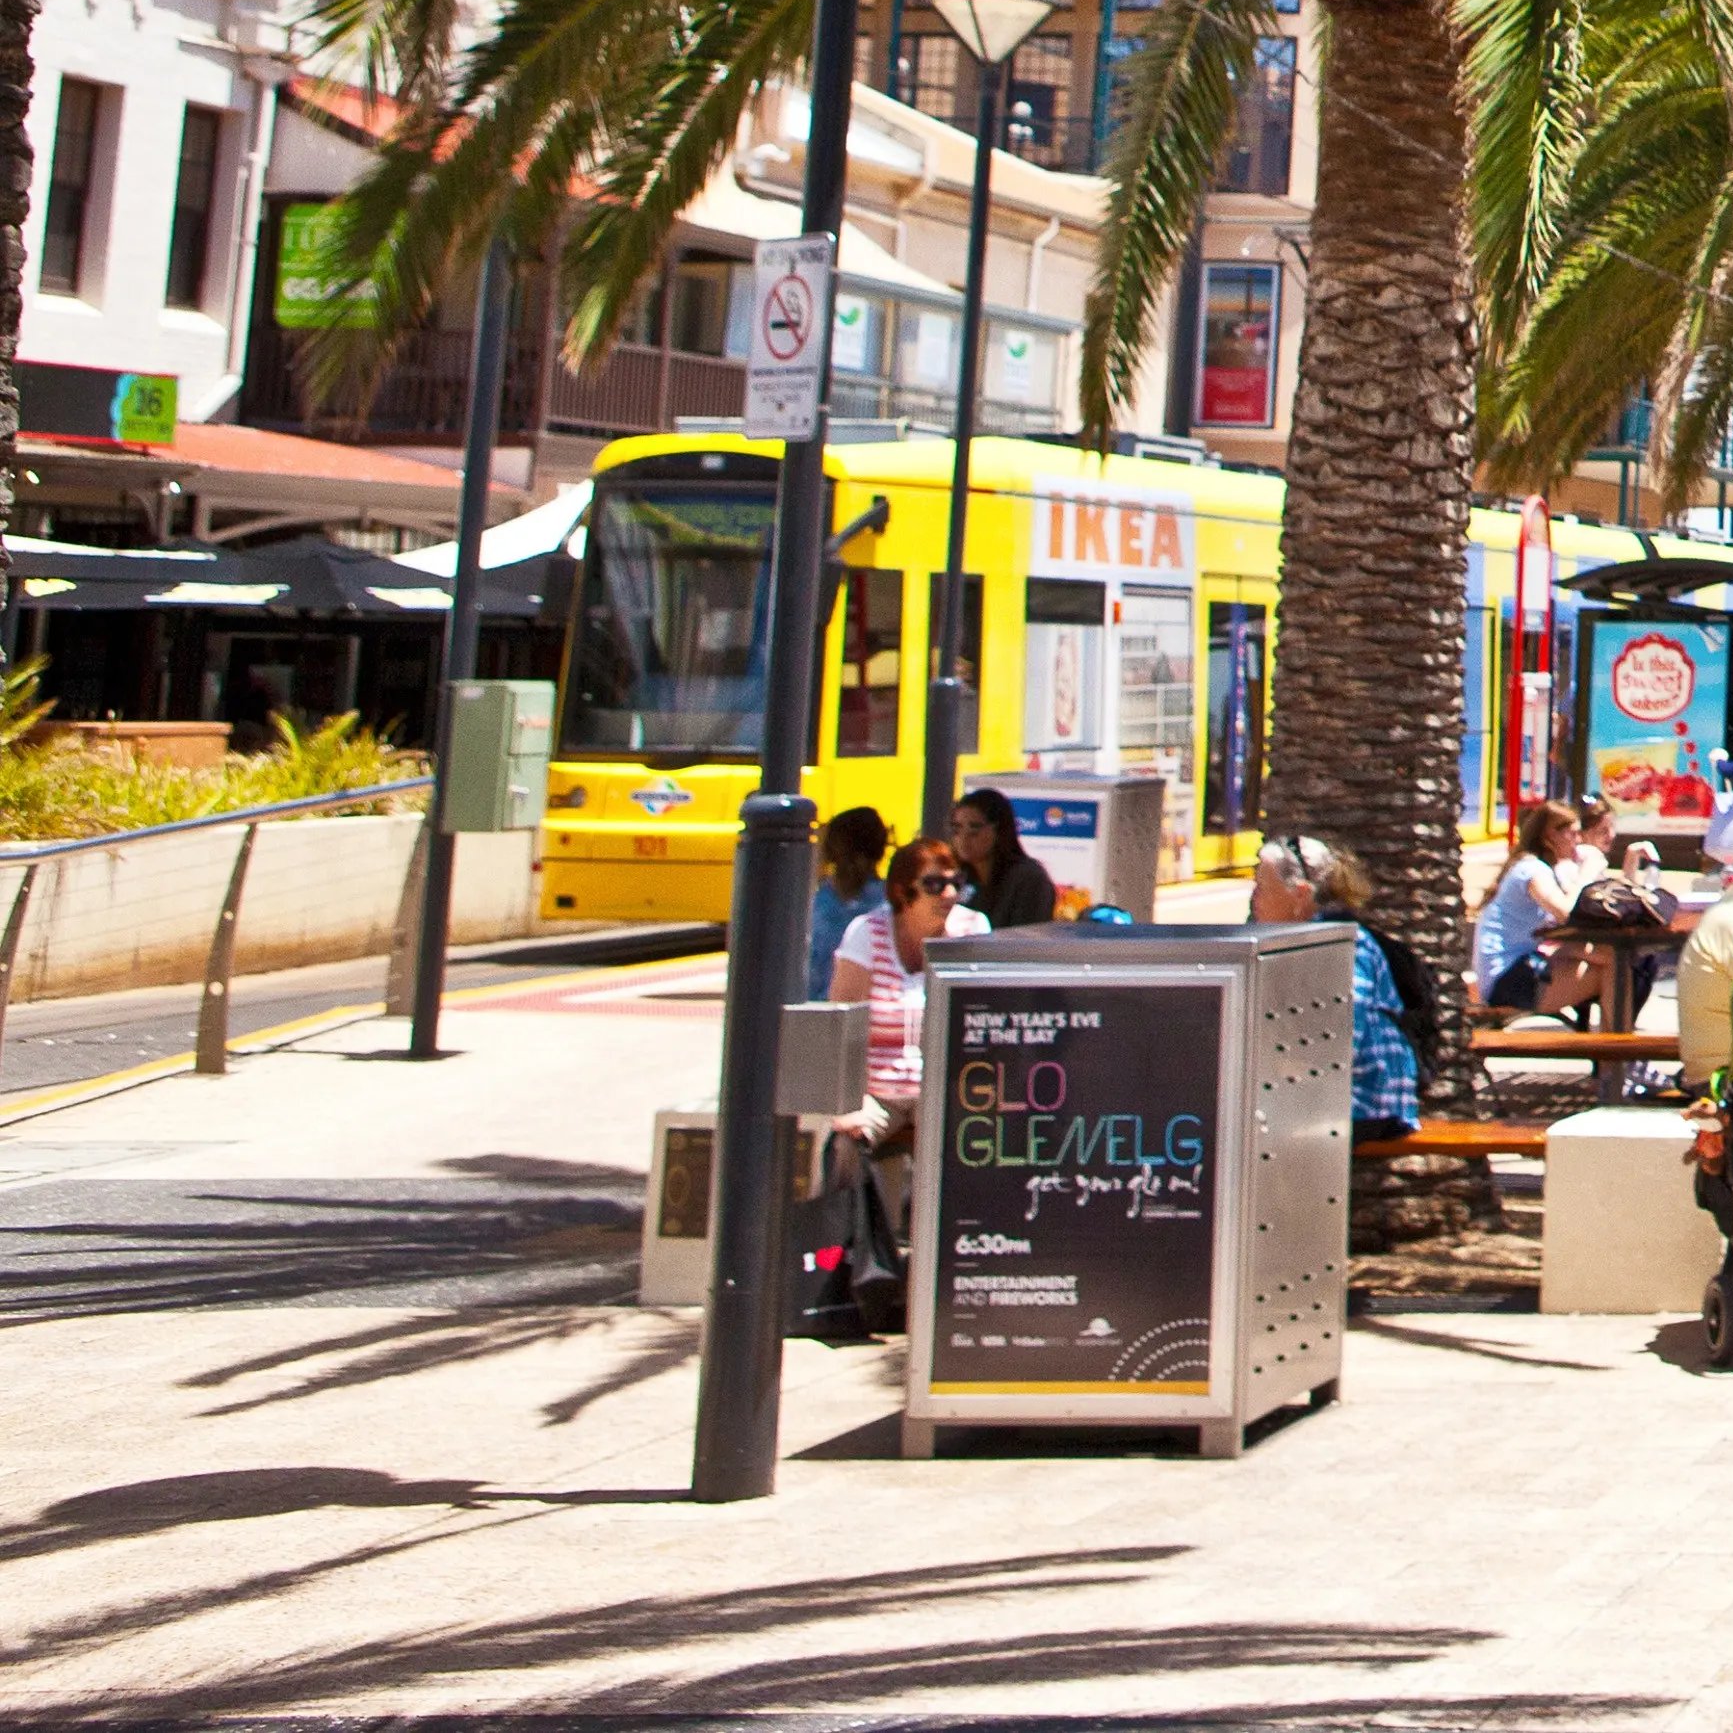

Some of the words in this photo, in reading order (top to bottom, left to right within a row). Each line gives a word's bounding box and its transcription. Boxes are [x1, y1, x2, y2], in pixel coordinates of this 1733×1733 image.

[1049, 491, 1183, 568] IKEA
[963, 1012, 1006, 1028] NEW
[1009, 1012, 1067, 1028] YEAR'S
[1070, 1012, 1103, 1028] EVE
[963, 1029, 985, 1044] AT
[990, 1029, 1019, 1044] THE
[1023, 1029, 1058, 1044] BAY
[958, 1061, 1067, 1112] GLO
[957, 1114, 1204, 1166] GLENELG
[954, 1233, 1032, 1255] 6:30PM
[953, 1275, 1079, 1290] ENTERTAINMENT
[953, 1291, 987, 1306] AND
[989, 1291, 1079, 1306] FIREWORKS
